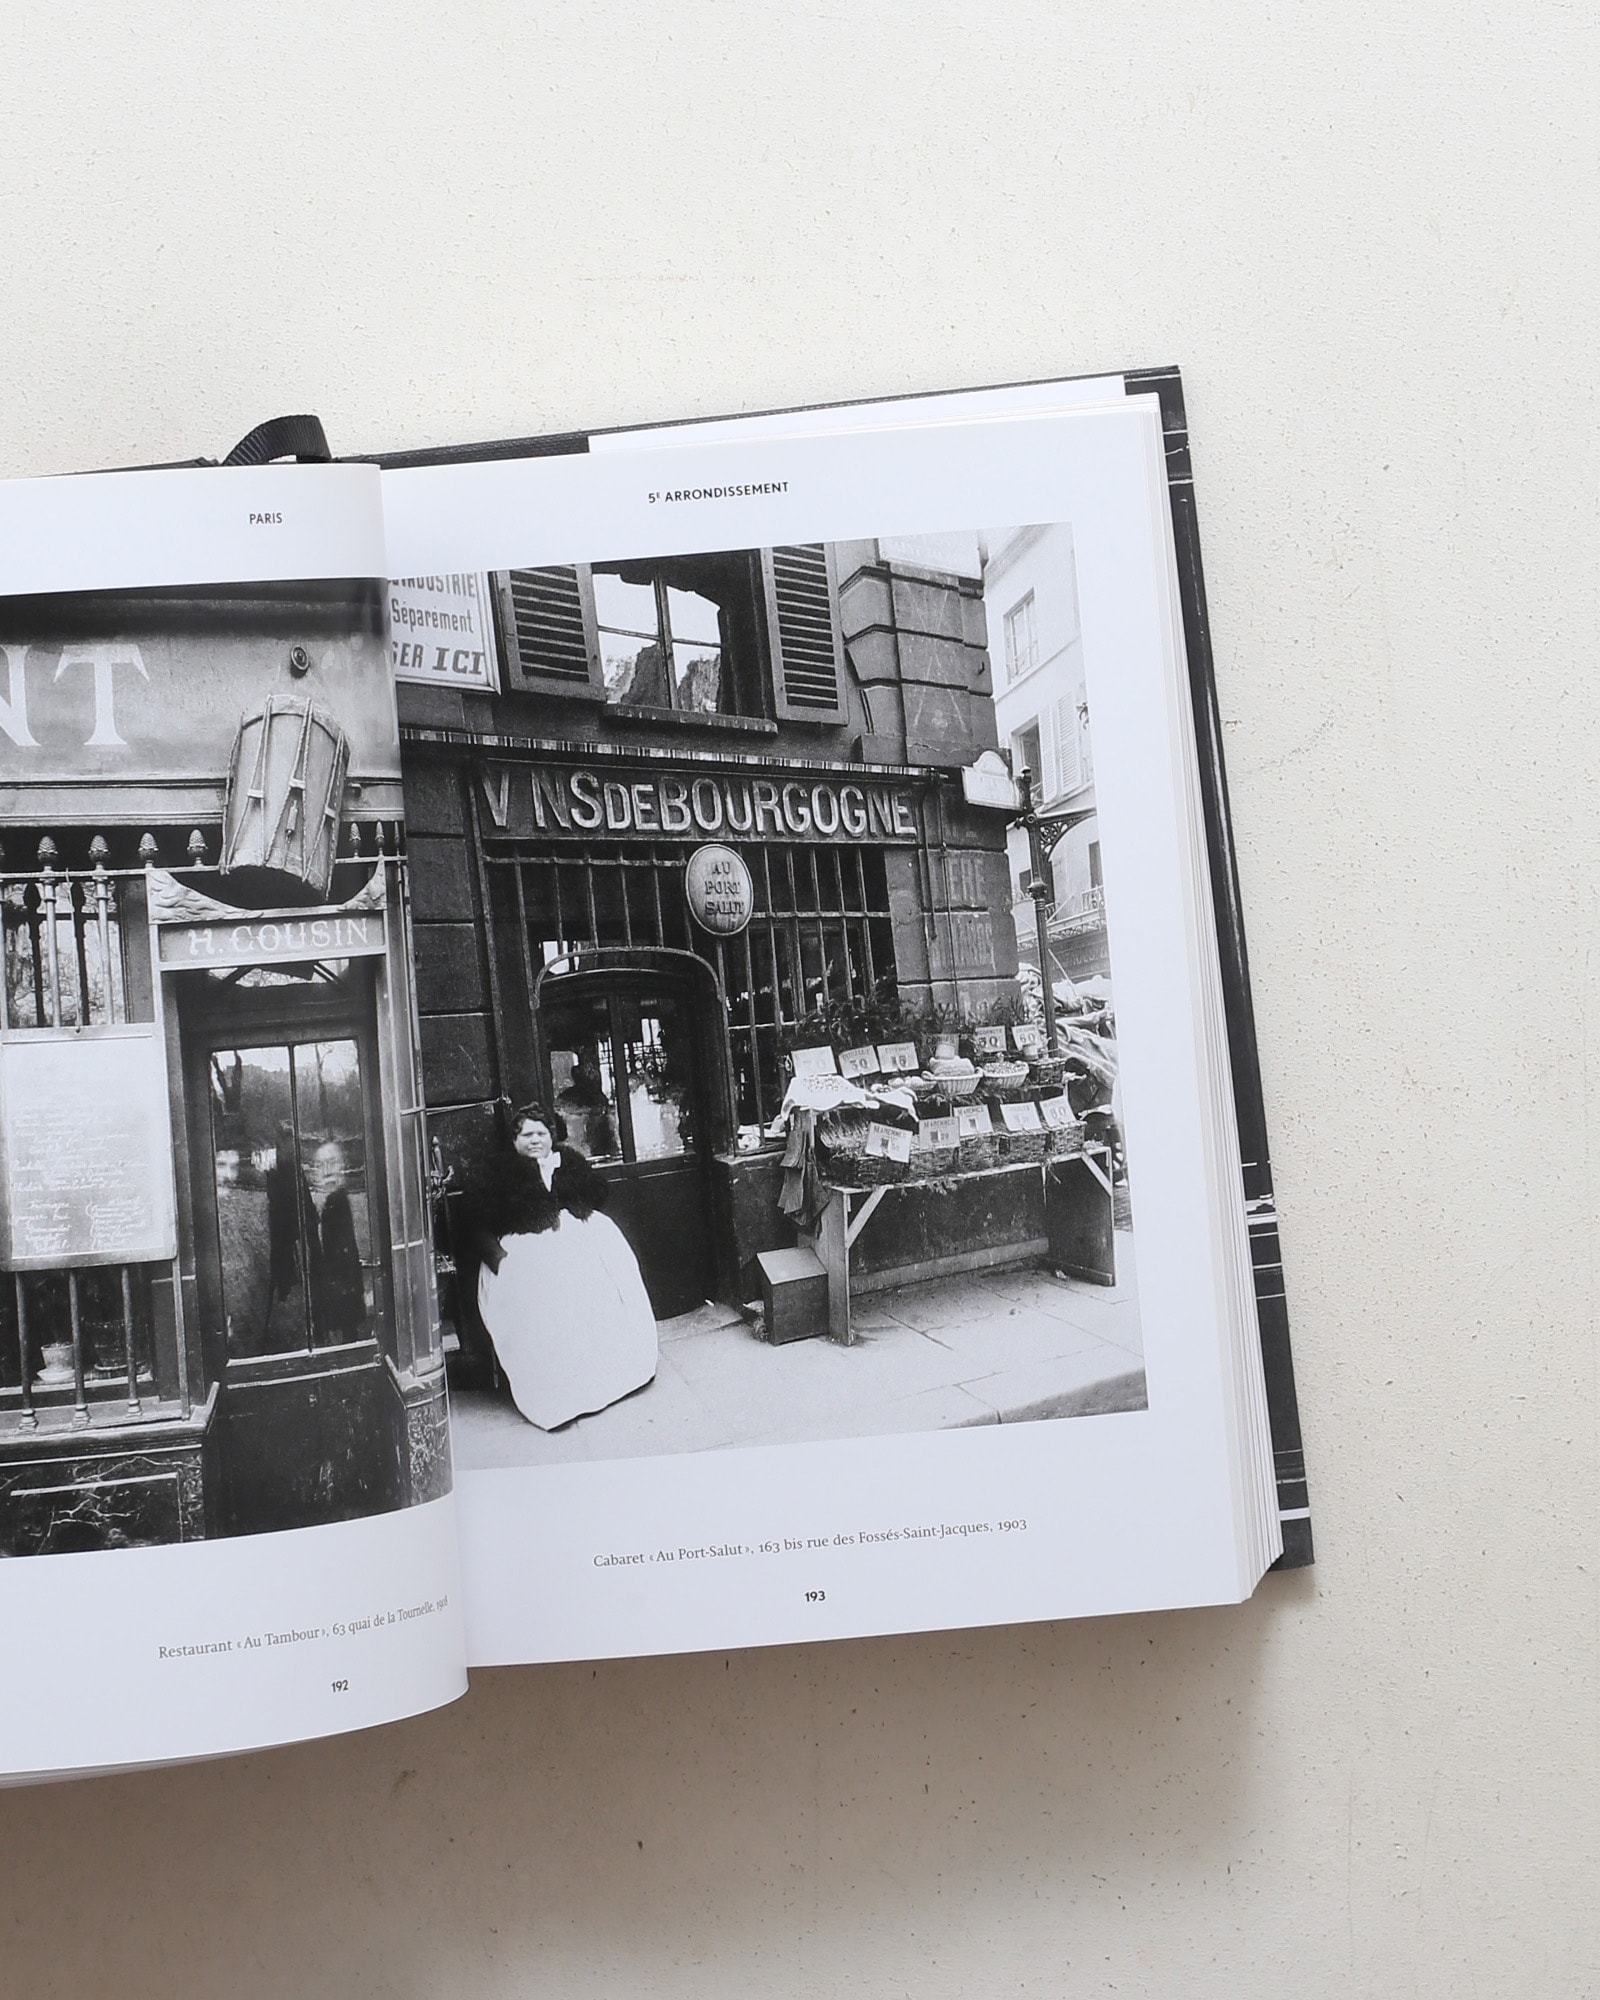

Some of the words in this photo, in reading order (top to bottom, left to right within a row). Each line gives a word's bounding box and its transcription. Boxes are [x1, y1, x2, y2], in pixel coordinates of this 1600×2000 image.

[665, 481, 789, 503] ARRONDISSEMENT
[249, 511, 283, 524] PARIS
[432, 646, 486, 676] ICI
[603, 781, 661, 832] DE
[658, 775, 917, 836] BOURGOGNE
[711, 860, 731, 875] AU
[704, 880, 742, 895] PORT
[705, 900, 746, 916] SALUT
[187, 927, 225, 956] H.
[229, 917, 368, 953] COUSIN
[593, 1553, 645, 1568] Cabaret
[759, 1541, 780, 1554] 163
[784, 1538, 803, 1551] bis
[807, 1538, 829, 1549] rue
[833, 1534, 855, 1546] des
[998, 1519, 1027, 1532] 1903
[804, 1590, 827, 1603] 193
[158, 1640, 233, 1659] Restaurant
[332, 1622, 346, 1636] 63
[348, 1615, 371, 1635] quai
[373, 1614, 386, 1628] de
[387, 1611, 396, 1624] la
[397, 1601, 435, 1622] Tournelle,
[331, 1679, 349, 1693] 192
